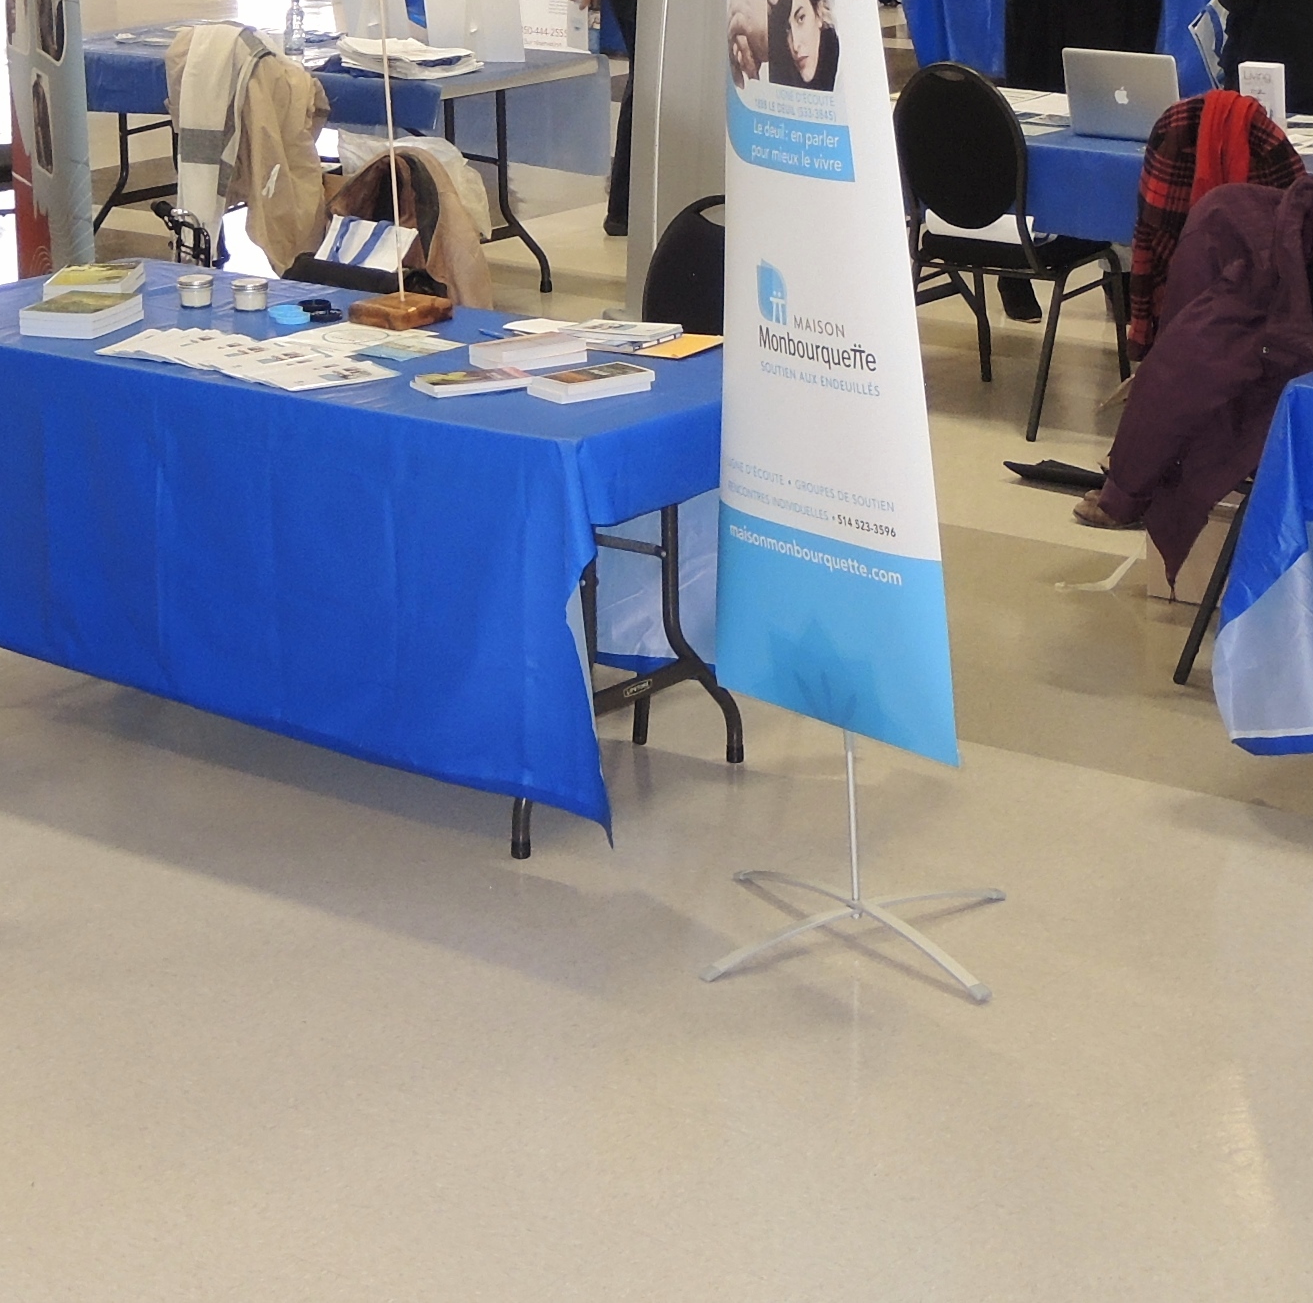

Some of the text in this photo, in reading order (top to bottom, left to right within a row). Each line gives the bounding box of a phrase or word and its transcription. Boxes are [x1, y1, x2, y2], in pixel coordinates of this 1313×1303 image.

[753, 118, 763, 135] Le
[790, 130, 803, 143] en
[805, 129, 840, 149] parler
[751, 144, 842, 172] pour mieux le vivre
[794, 314, 846, 338] MAISON
[759, 324, 877, 372] Monbourquette
[760, 360, 881, 397] SOUTIEN AUX ENDEUILLÉS
[795, 478, 835, 500] GROUPES
[837, 490, 850, 503] DE
[852, 491, 895, 513] SOUTIEN
[837, 514, 853, 528] 514
[855, 518, 897, 539] 523-3596
[729, 522, 902, 587] maisonmonbourquette.com
